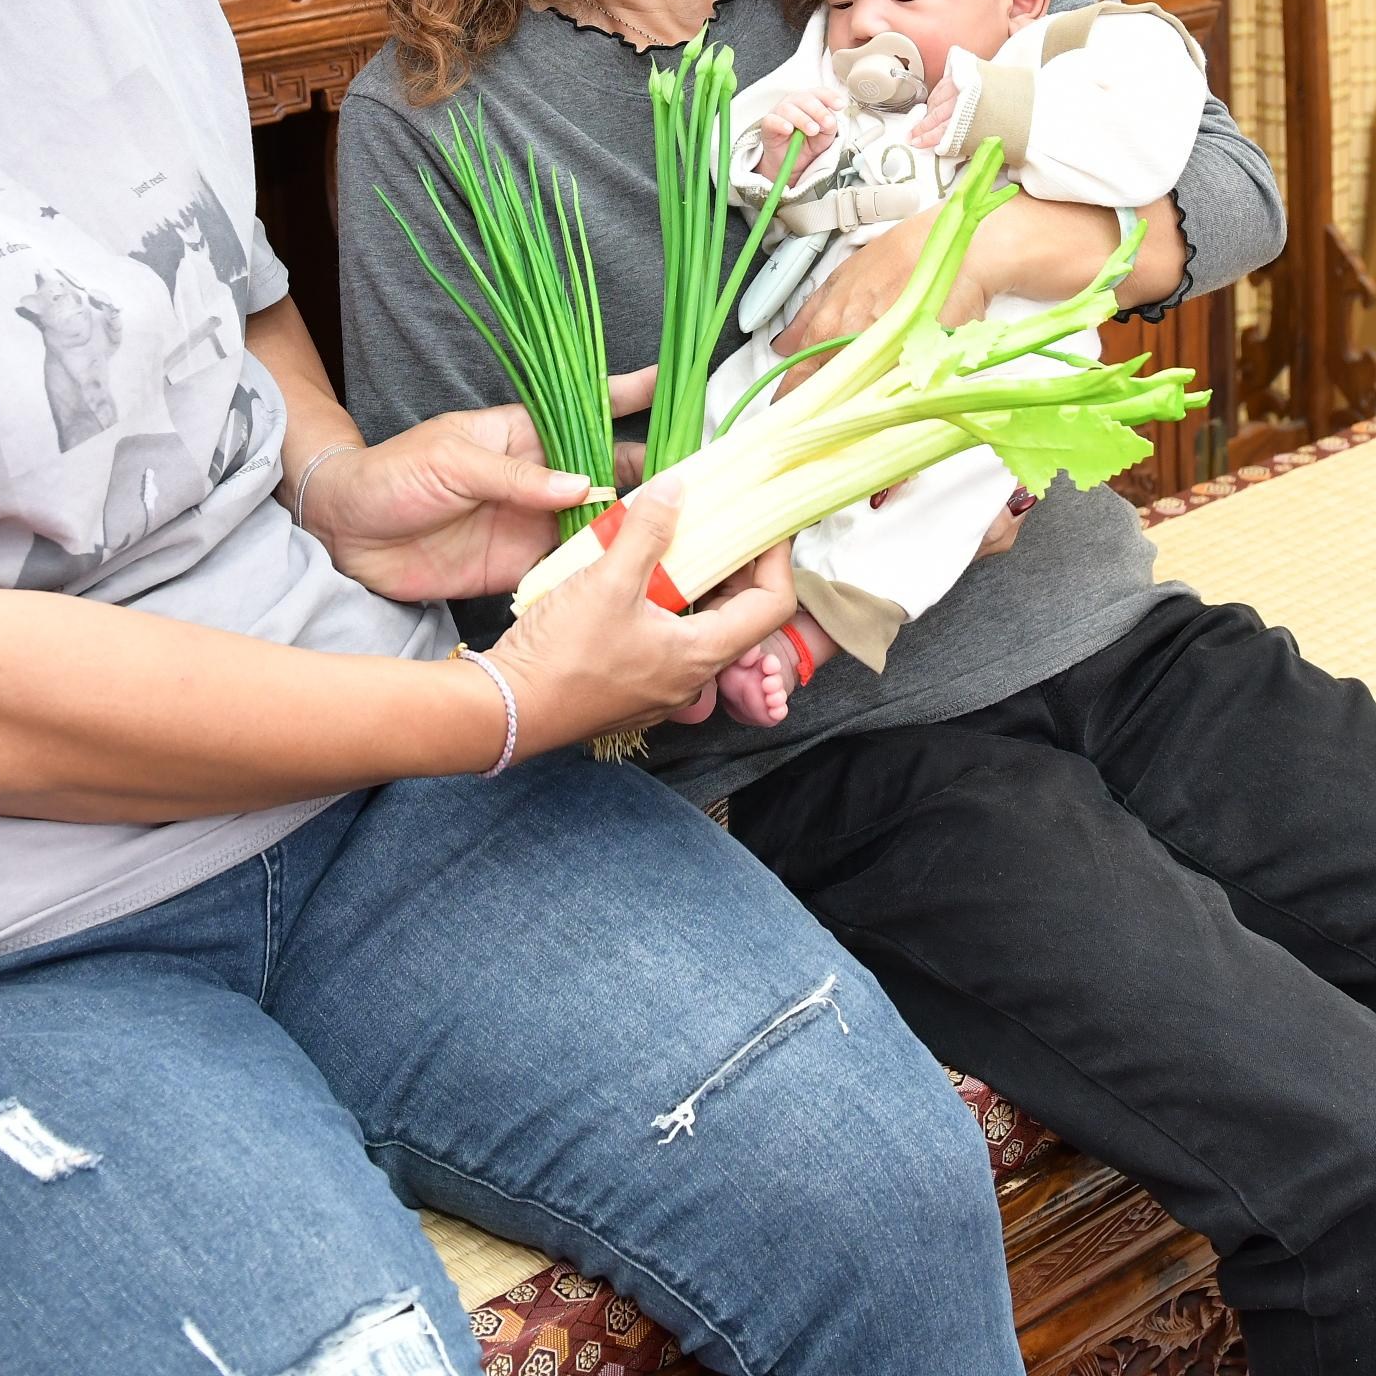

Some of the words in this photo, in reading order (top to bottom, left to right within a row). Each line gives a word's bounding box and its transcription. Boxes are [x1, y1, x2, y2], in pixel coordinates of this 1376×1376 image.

[132, 182, 151, 197] just
[149, 172, 167, 186] rest
[239, 455, 271, 474] reading
